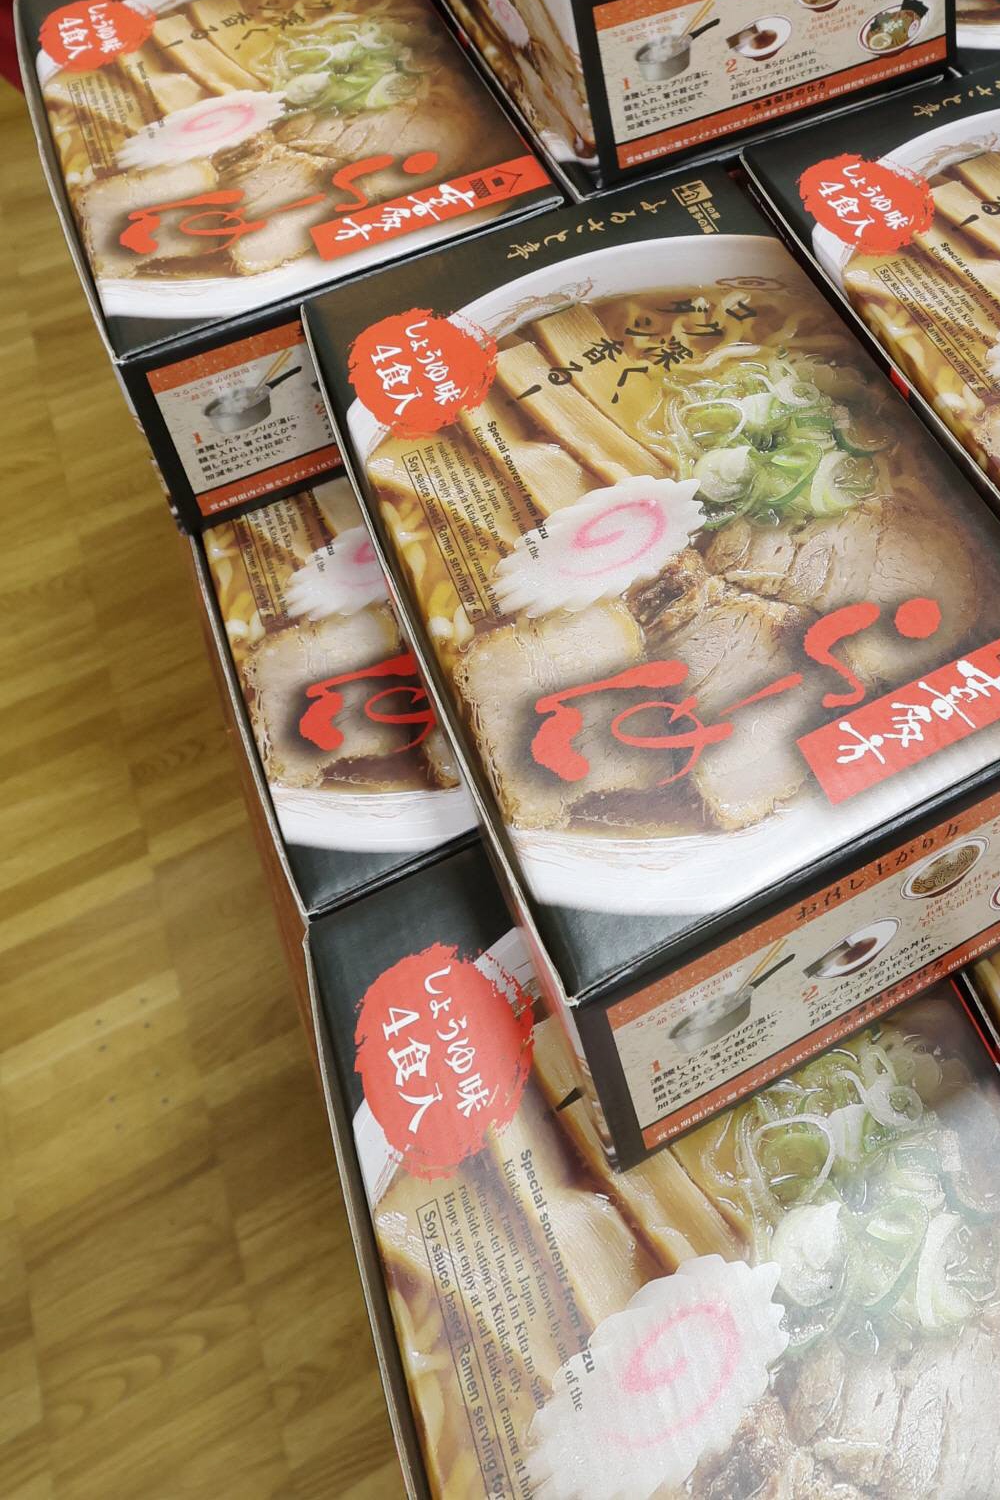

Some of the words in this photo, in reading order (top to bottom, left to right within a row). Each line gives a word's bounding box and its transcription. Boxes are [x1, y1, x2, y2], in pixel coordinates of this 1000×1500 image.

[57, 18, 92, 60] 4食入
[87, 4, 123, 53] しょうゆ味
[725, 58, 738, 73] 2
[118, 152, 438, 253] らーめん
[336, 185, 473, 240] 喜多方
[819, 181, 874, 237] 4食入
[840, 163, 912, 230] しょうゆ味
[507, 200, 667, 258] ふるさと亭
[938, 242, 966, 268] Special
[962, 268, 994, 298] souvenir
[370, 344, 422, 415] 4食入
[403, 320, 463, 405] しょうゆ味
[448, 469, 466, 495] station
[463, 503, 485, 537] Kitakata
[465, 477, 485, 504] located
[481, 479, 492, 488] in
[483, 487, 504, 514] Japan.
[484, 420, 509, 454] Special
[502, 454, 528, 493] souvenir
[521, 493, 539, 516] from
[532, 517, 550, 540] Aizu
[405, 454, 422, 472] Soy
[414, 472, 431, 497] sauce
[435, 524, 458, 556] Ramen
[447, 556, 472, 592] serving
[464, 591, 479, 606] for
[527, 545, 542, 560] the
[530, 597, 940, 780] らーめん
[801, 982, 819, 1003] 2
[421, 964, 493, 1118] しょうゆ味
[382, 1006, 443, 1135] 4食入
[650, 1058, 662, 1074] 1
[439, 1191, 461, 1229] Hope
[457, 1182, 481, 1239] roadside
[501, 1158, 527, 1215] Kitakata
[420, 1209, 441, 1242] Soy
[449, 1228, 465, 1255] you
[500, 1213, 519, 1257] ramen
[431, 1242, 451, 1290] sauce
[456, 1252, 478, 1293] enjoy
[472, 1238, 495, 1286] station
[493, 1253, 517, 1304] located
[513, 1257, 526, 1273] in
[517, 1147, 547, 1210] Special
[538, 1210, 570, 1284] souvenir
[561, 1285, 584, 1329] from
[575, 1330, 597, 1374] Aizu
[485, 1284, 499, 1303] in
[507, 1302, 522, 1320] in
[515, 1272, 541, 1323] Japan.
[535, 1271, 558, 1320] known
[473, 1308, 491, 1339] real
[490, 1301, 517, 1366] Kitakata
[512, 1320, 532, 1354] Kita
[547, 1318, 564, 1341] by
[456, 1340, 483, 1403] Ramen
[505, 1364, 527, 1402] city.
[522, 1354, 535, 1375] no
[563, 1367, 579, 1387] of
[569, 1384, 586, 1413] the
[469, 1402, 500, 1473] serving
[499, 1405, 520, 1456] ramen
